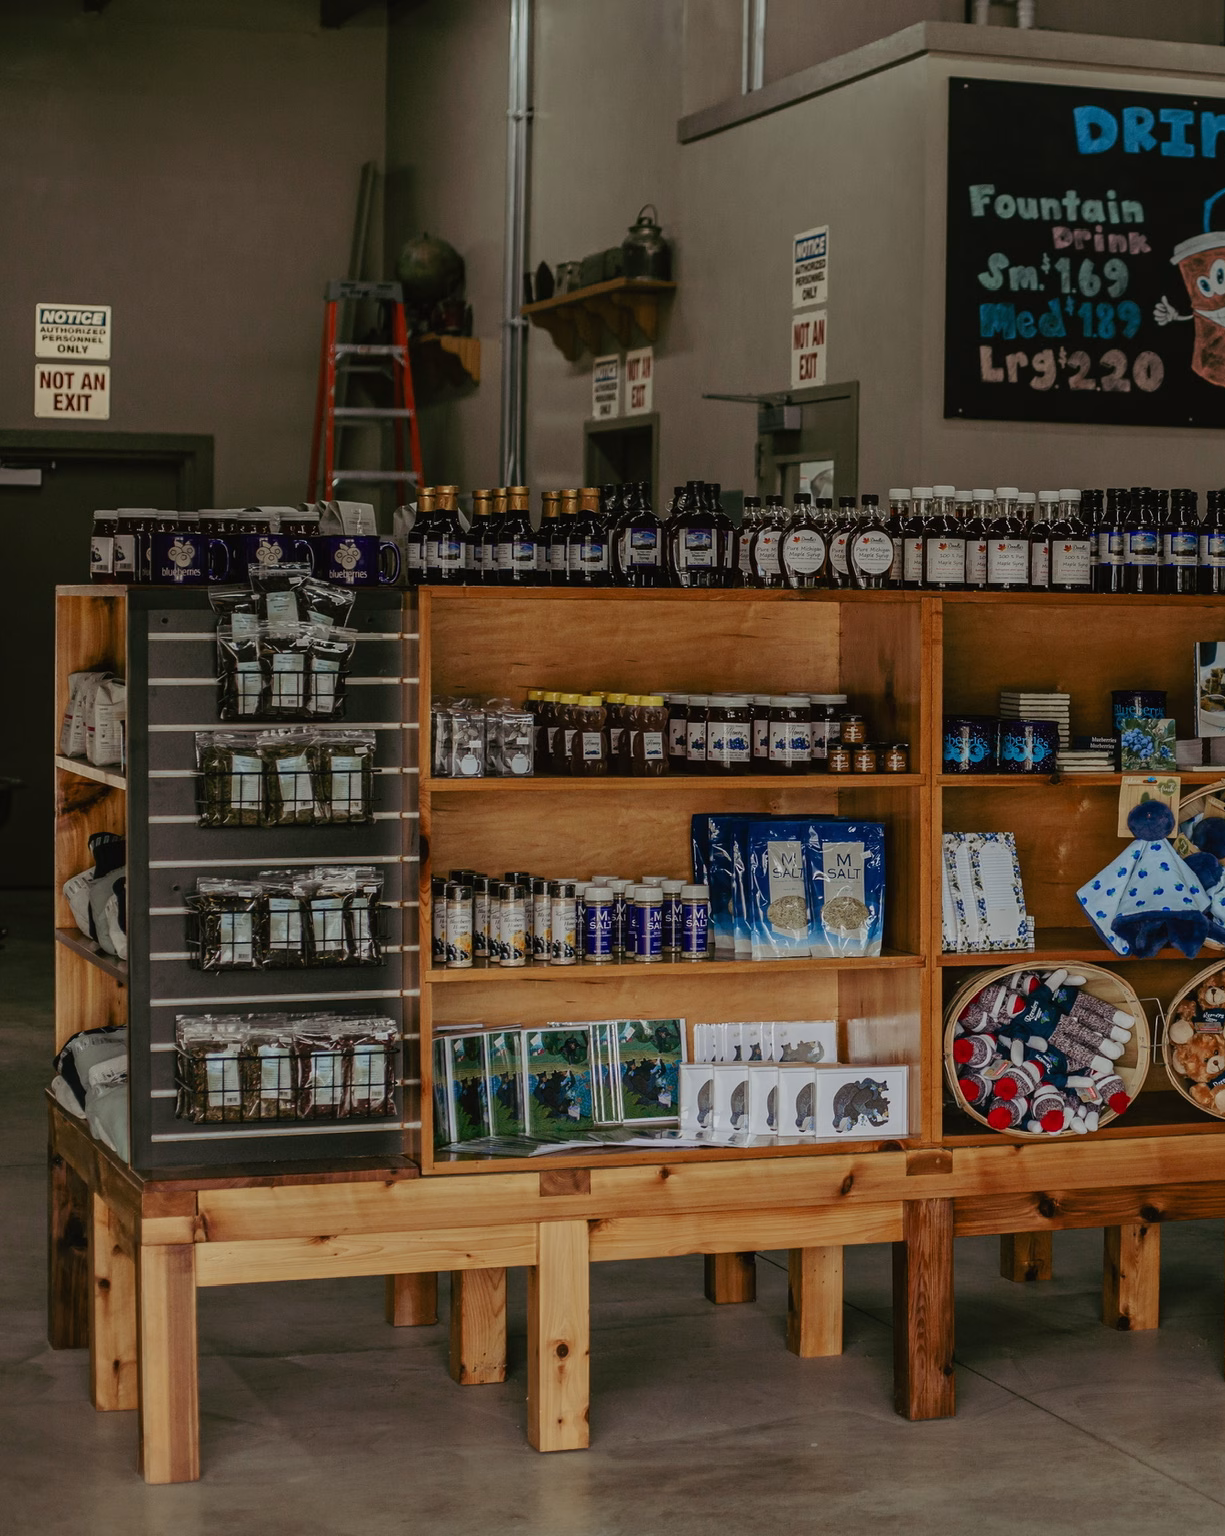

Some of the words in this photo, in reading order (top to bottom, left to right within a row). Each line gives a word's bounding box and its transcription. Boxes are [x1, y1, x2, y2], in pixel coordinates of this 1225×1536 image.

[969, 184, 1145, 224] Fountain
[1052, 225, 1152, 255] Drink
[797, 237, 826, 261] NOTICE
[795, 259, 826, 275] AUTHORIZED
[795, 272, 825, 287] PERSONNEL
[977, 252, 1045, 291] Sm.
[1040, 252, 1129, 298] $1.69
[802, 286, 818, 301] ONLY
[42, 310, 105, 325] NOTICE
[979, 297, 1067, 340] Med
[40, 327, 106, 335] AUTHORIZED
[793, 322, 810, 350] NOT
[812, 320, 825, 347] AN
[42, 335, 103, 344] PERSONNEL
[57, 344, 88, 354] ONLY
[799, 353, 818, 381] EXIT
[1059, 345, 1165, 393] $2.20
[40, 371, 75, 389] NOT
[81, 373, 105, 391] AN
[53, 393, 92, 412] EXIT
[161, 567, 202, 578] blueberries
[328, 569, 368, 579] blueberries
[836, 853, 852, 867] M
[772, 867, 804, 879] SALT
[827, 868, 861, 880] SALT
[596, 910, 608, 921] M
[611, 913, 627, 922] SAL
[692, 910, 704, 921] M
[589, 921, 613, 930] SALT
[647, 921, 663, 930] SAL
[686, 919, 709, 928] SALT
